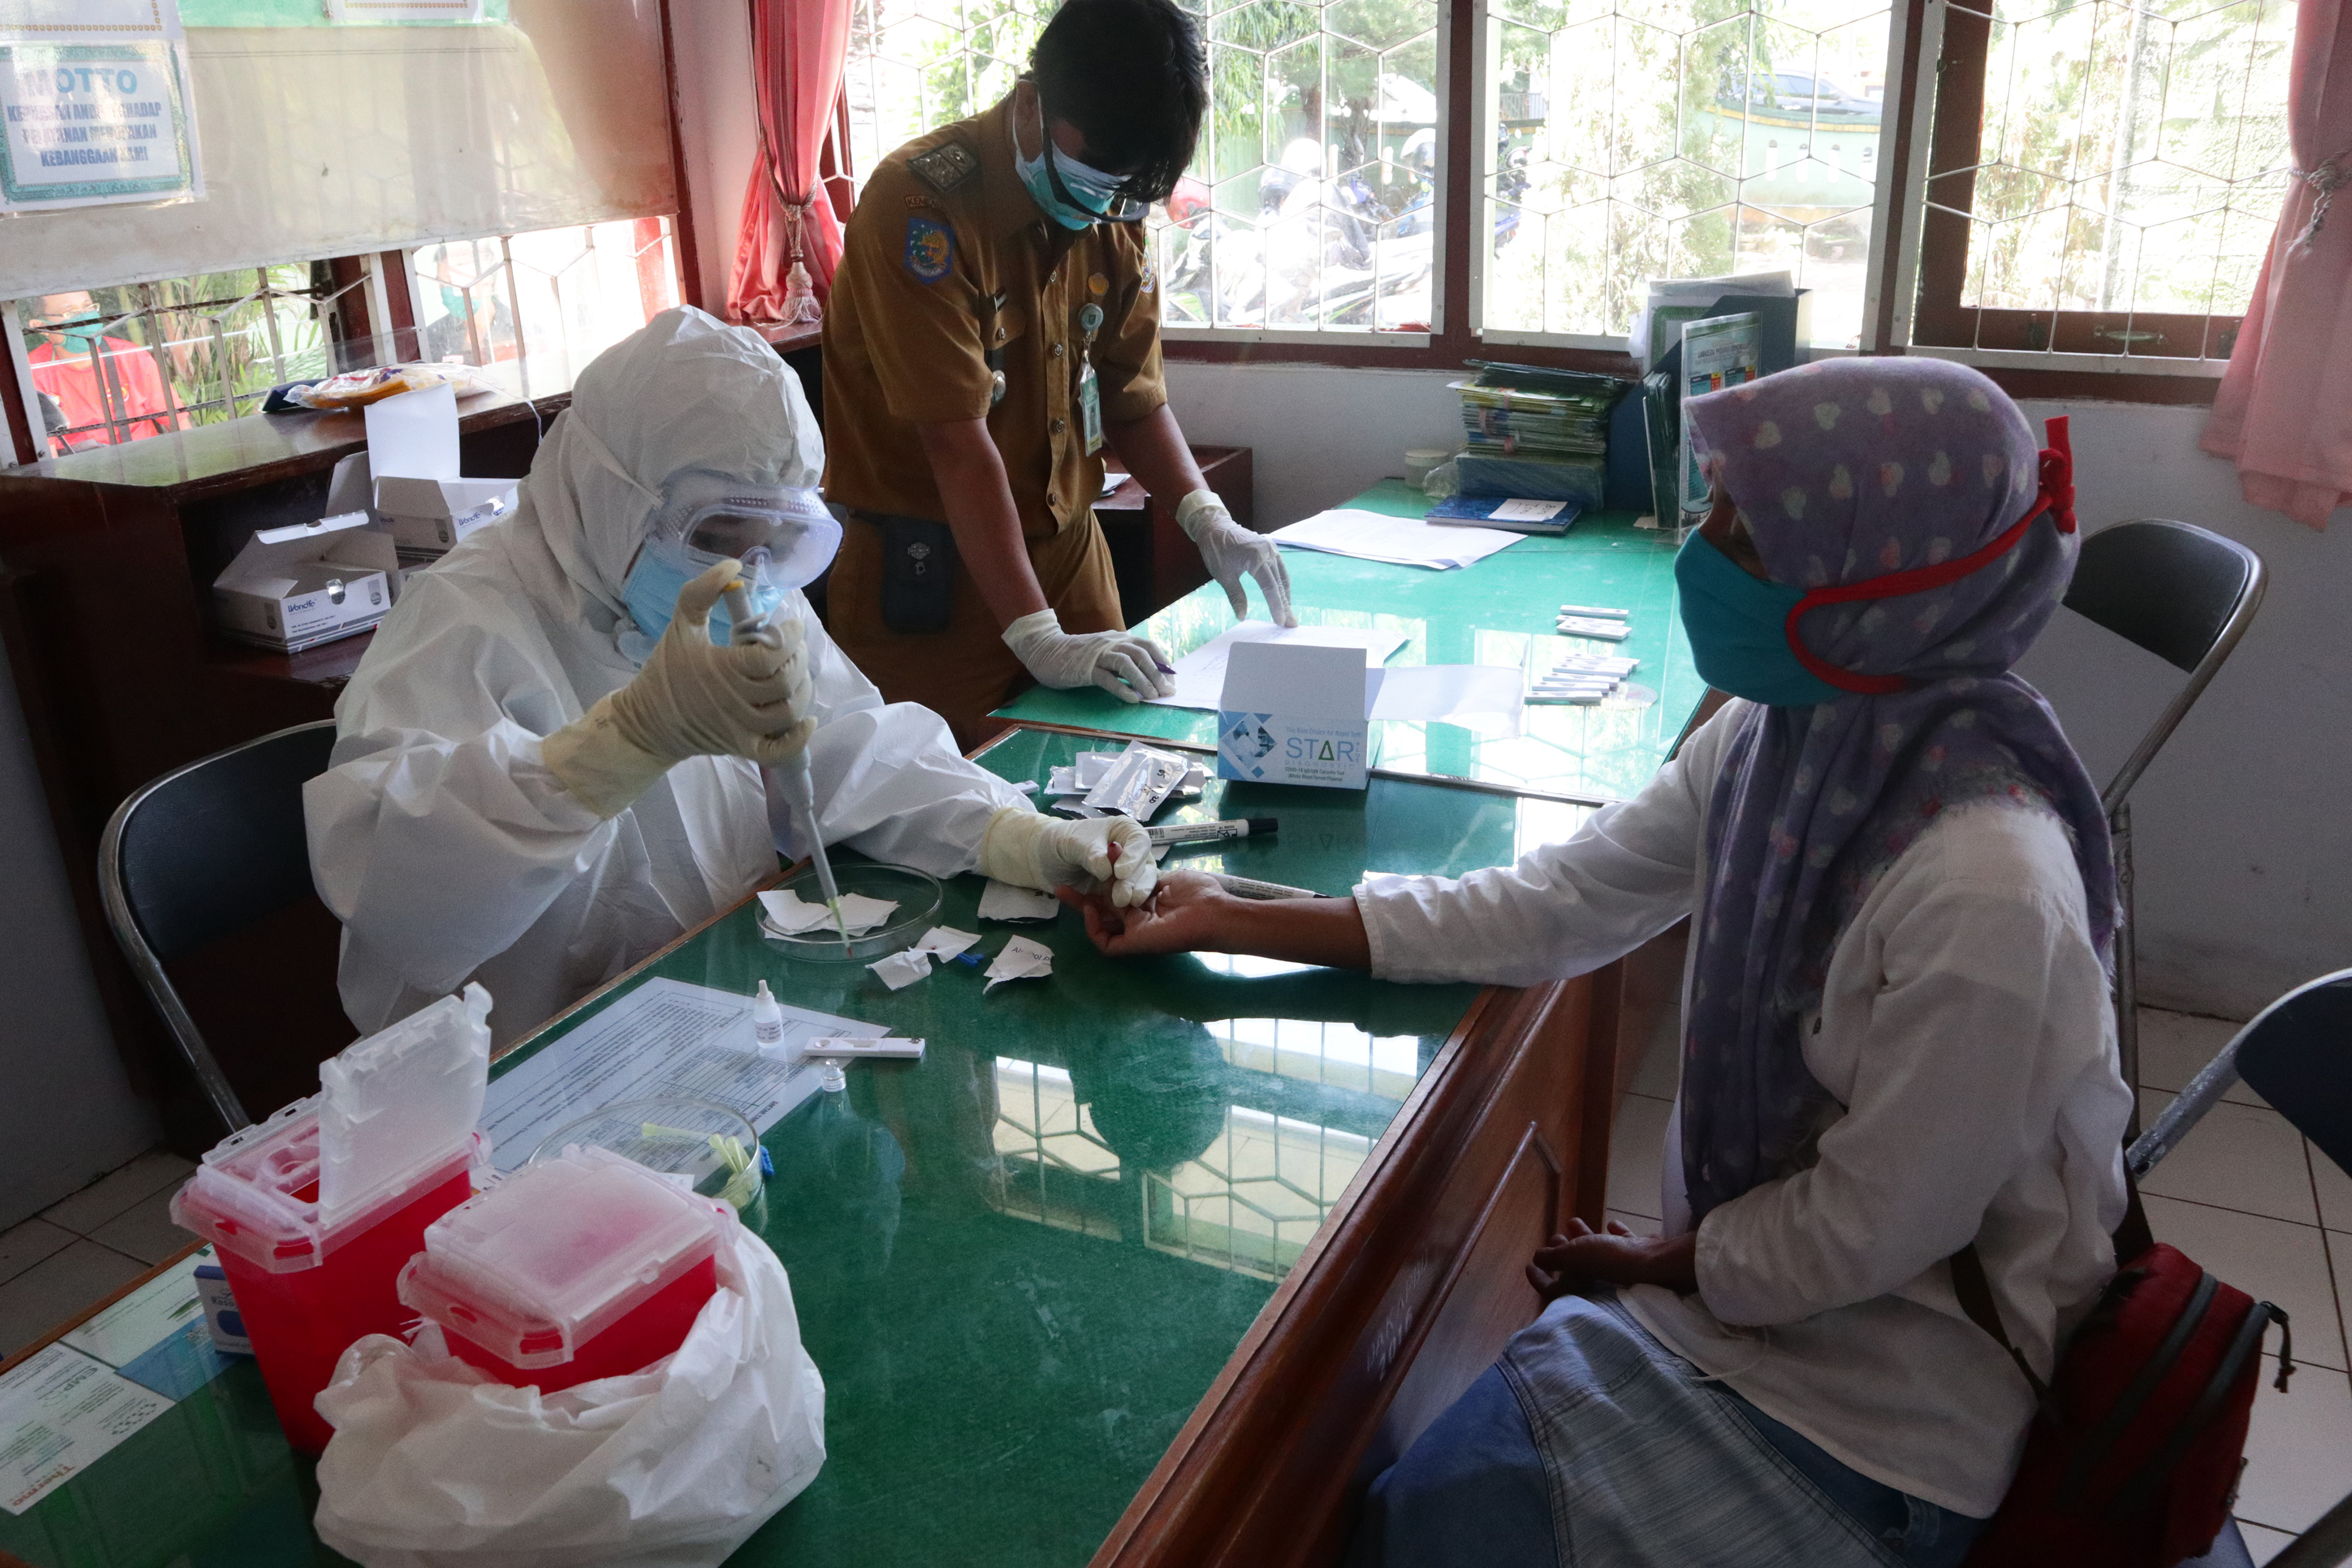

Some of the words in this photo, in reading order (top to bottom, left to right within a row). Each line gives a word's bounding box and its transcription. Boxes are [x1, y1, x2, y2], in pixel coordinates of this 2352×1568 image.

[89, 123, 157, 142] MERAKAN
[41, 148, 118, 166] KEBANGGAAN
[459, 512, 481, 526] Wondfo
[288, 599, 316, 613] Wondfo
[1285, 759, 1355, 770] DIAGNOSTIC
[1012, 947, 1042, 960] Alol
